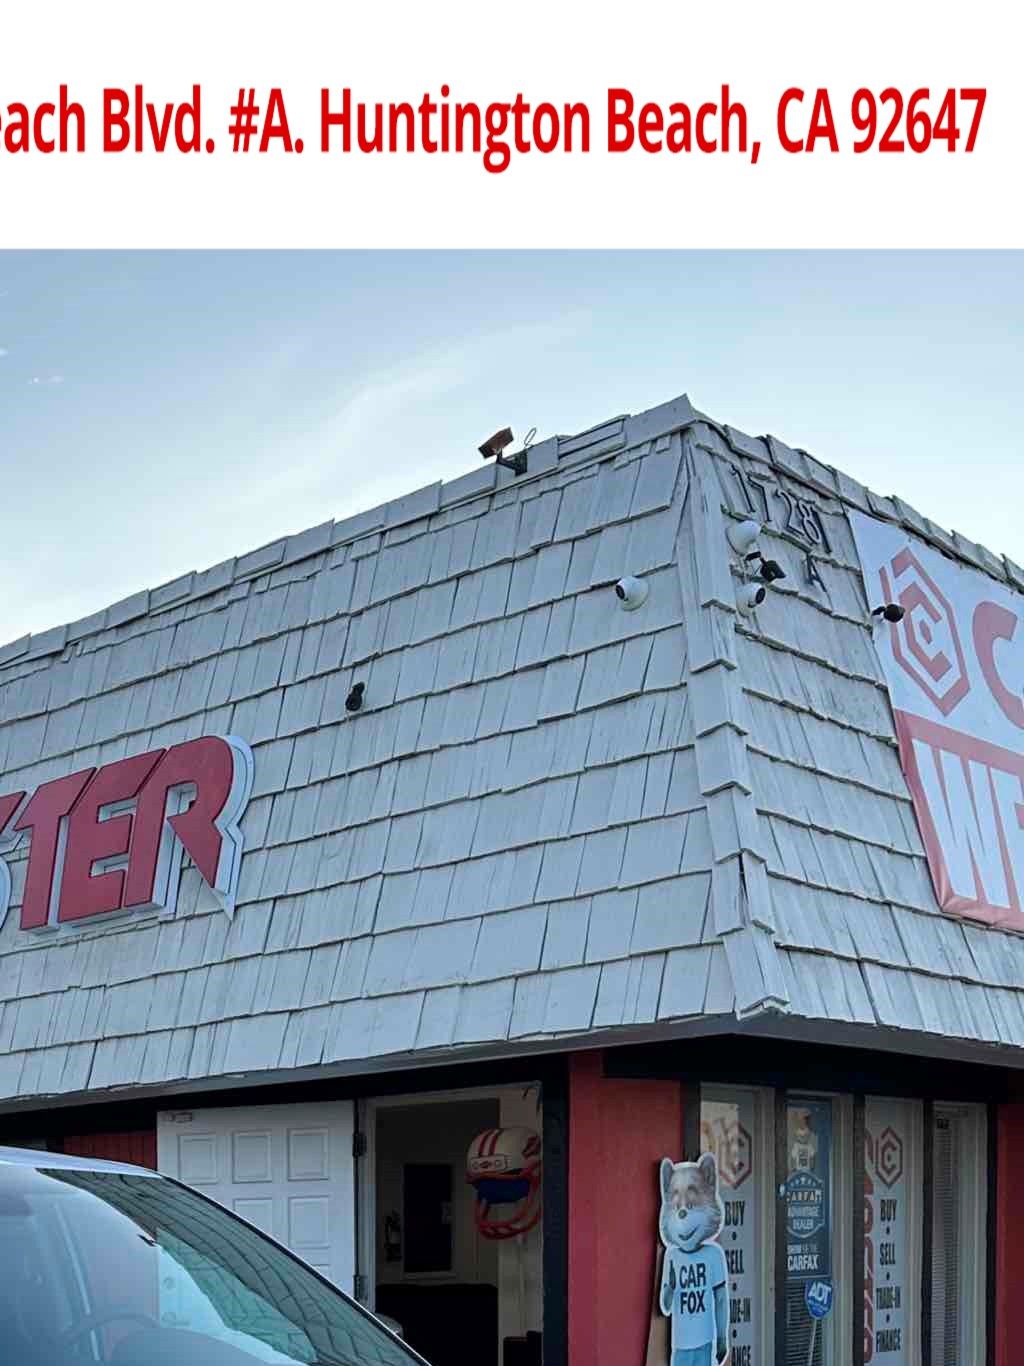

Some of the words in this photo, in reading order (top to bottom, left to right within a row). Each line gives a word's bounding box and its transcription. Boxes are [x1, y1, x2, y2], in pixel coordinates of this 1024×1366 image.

[724, 1200, 745, 1227] BUY
[879, 1199, 897, 1223] BUY
[787, 1255, 819, 1273] CARFAX
[879, 1242, 896, 1266] SELL
[679, 1262, 707, 1289] CAR
[680, 1290, 706, 1315] FOX
[808, 1281, 832, 1304] ADT
